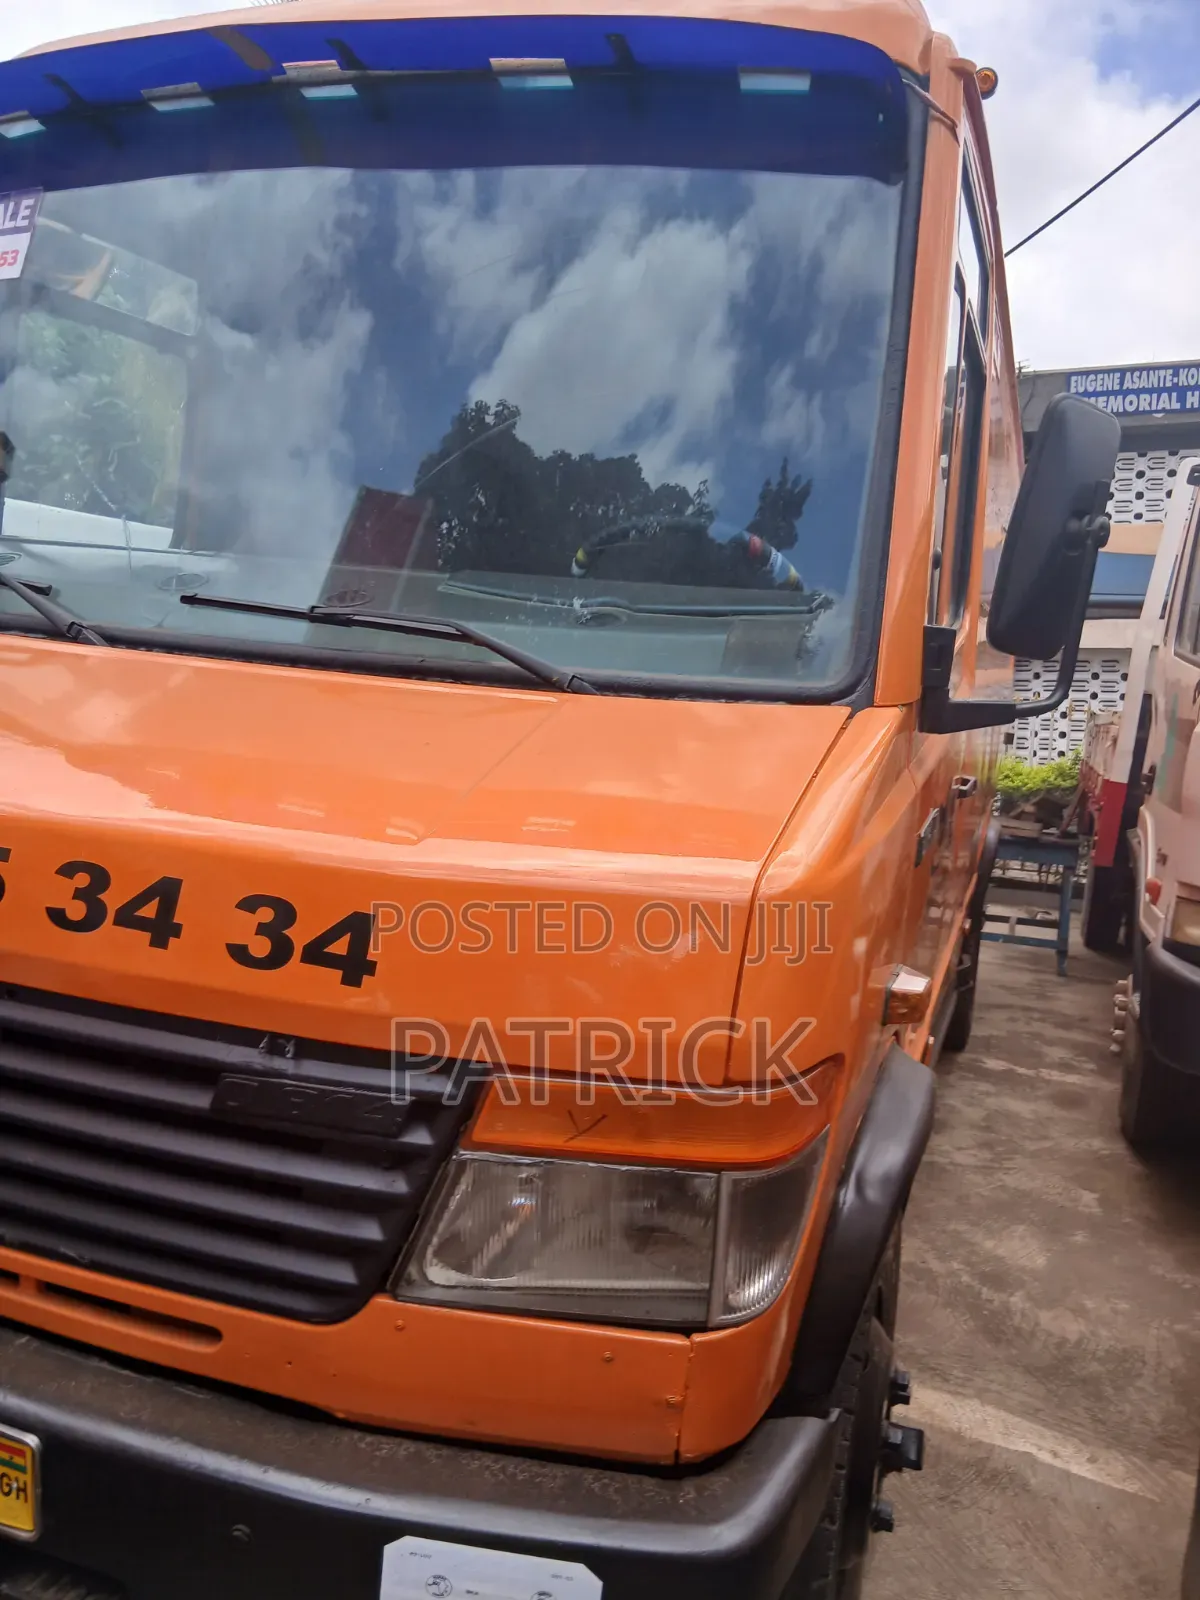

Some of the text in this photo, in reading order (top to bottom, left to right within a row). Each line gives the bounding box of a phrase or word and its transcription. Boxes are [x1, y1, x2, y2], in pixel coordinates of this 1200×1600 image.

[1069, 367, 1200, 394] EUGENE ASANTE-KO
[45, 860, 184, 950] 34
[225, 893, 378, 989] 34
[0, 1472, 28, 1503] GH
